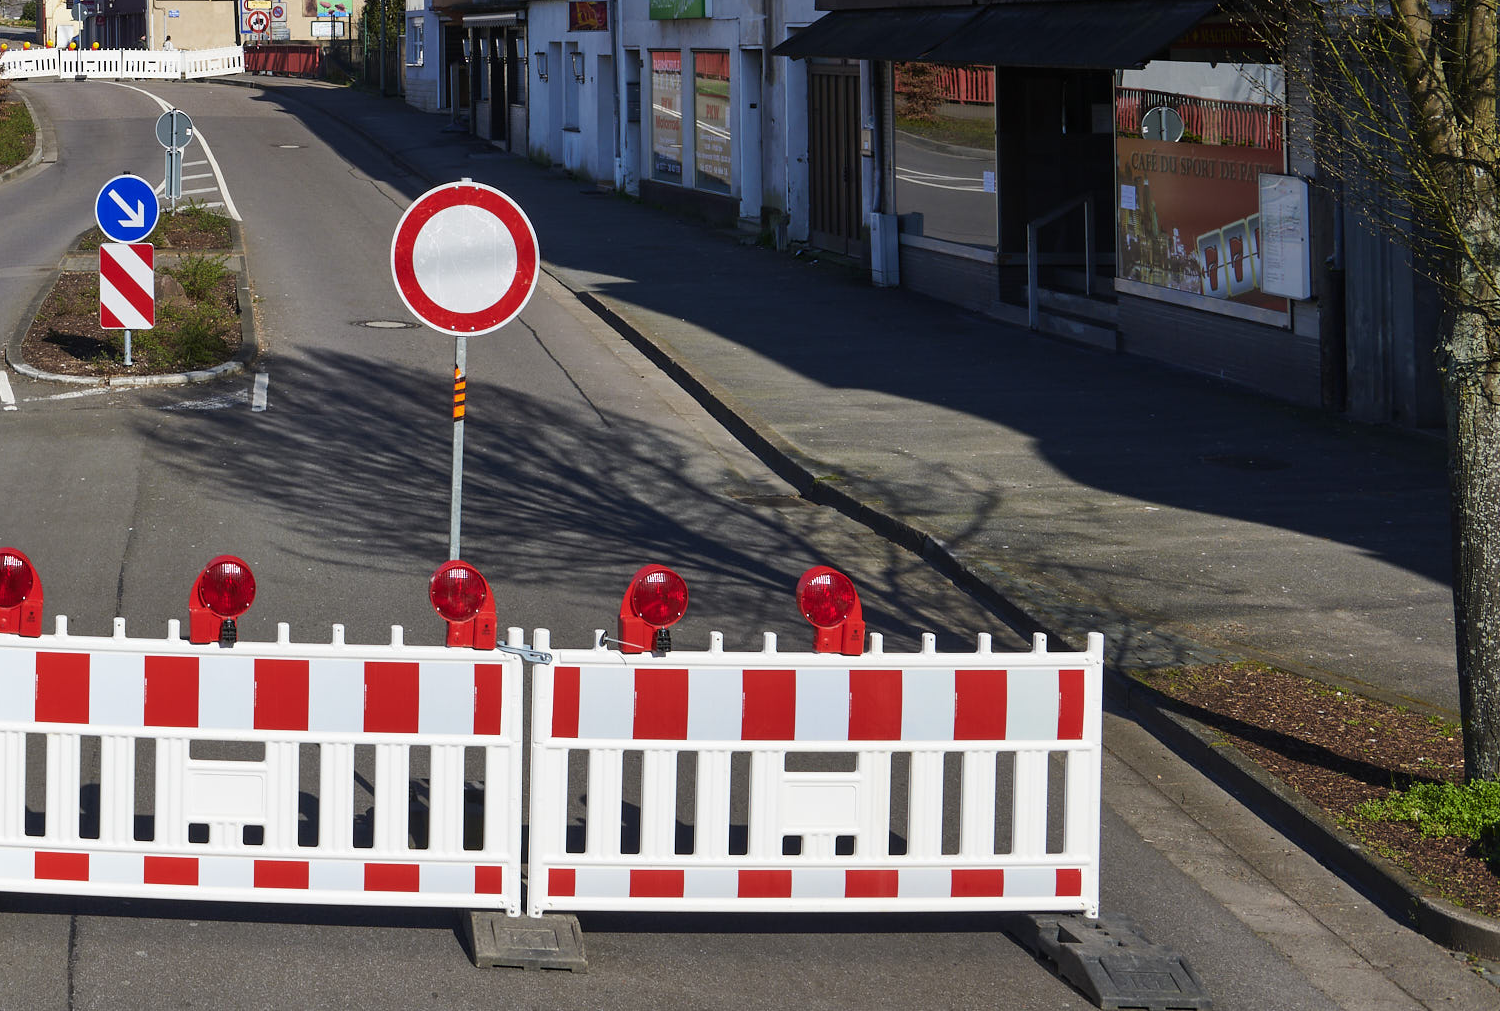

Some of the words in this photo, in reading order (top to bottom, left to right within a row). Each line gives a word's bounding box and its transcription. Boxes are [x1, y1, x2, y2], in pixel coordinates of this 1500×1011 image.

[706, 104, 719, 120] PKW
[1131, 149, 1157, 172] CAFÉ
[1160, 156, 1177, 174] DU
[1180, 157, 1215, 178] SPORT
[1220, 160, 1236, 180] DE
